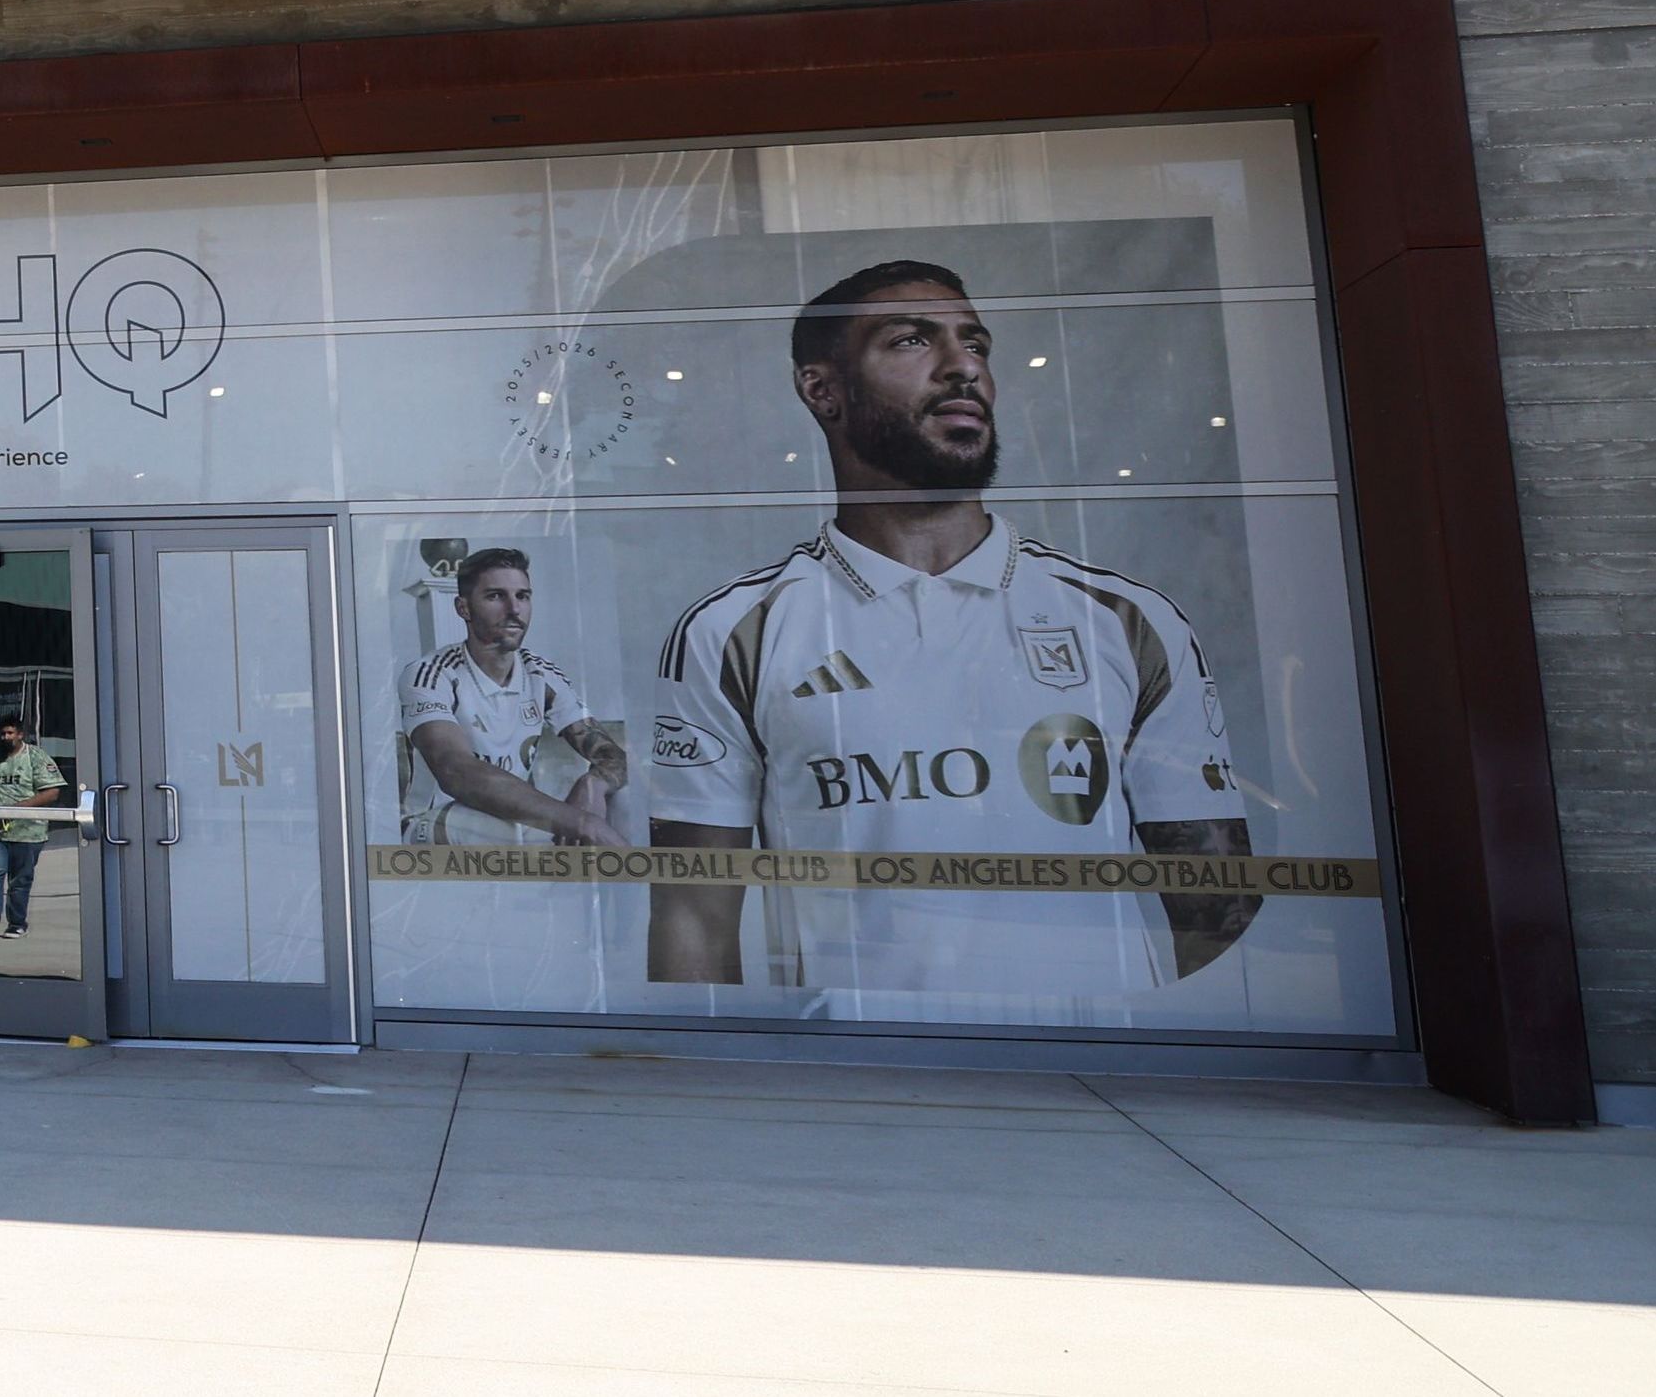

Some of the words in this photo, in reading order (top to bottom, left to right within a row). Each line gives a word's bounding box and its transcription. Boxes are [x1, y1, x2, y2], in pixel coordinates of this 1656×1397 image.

[505, 342, 597, 404] 2025/2026
[509, 416, 572, 460] JERSEY
[588, 359, 636, 459] SECONDARY
[807, 746, 990, 811] BMO
[376, 850, 432, 875] LOS
[443, 850, 572, 877] ANGELES
[581, 851, 743, 880] FOOTBALL
[751, 854, 830, 882] CLUB
[855, 857, 918, 885] LOS
[929, 858, 1070, 887] ANGELES
[1080, 859, 1257, 889] FOOTBALL
[1267, 862, 1353, 891] CLUB
